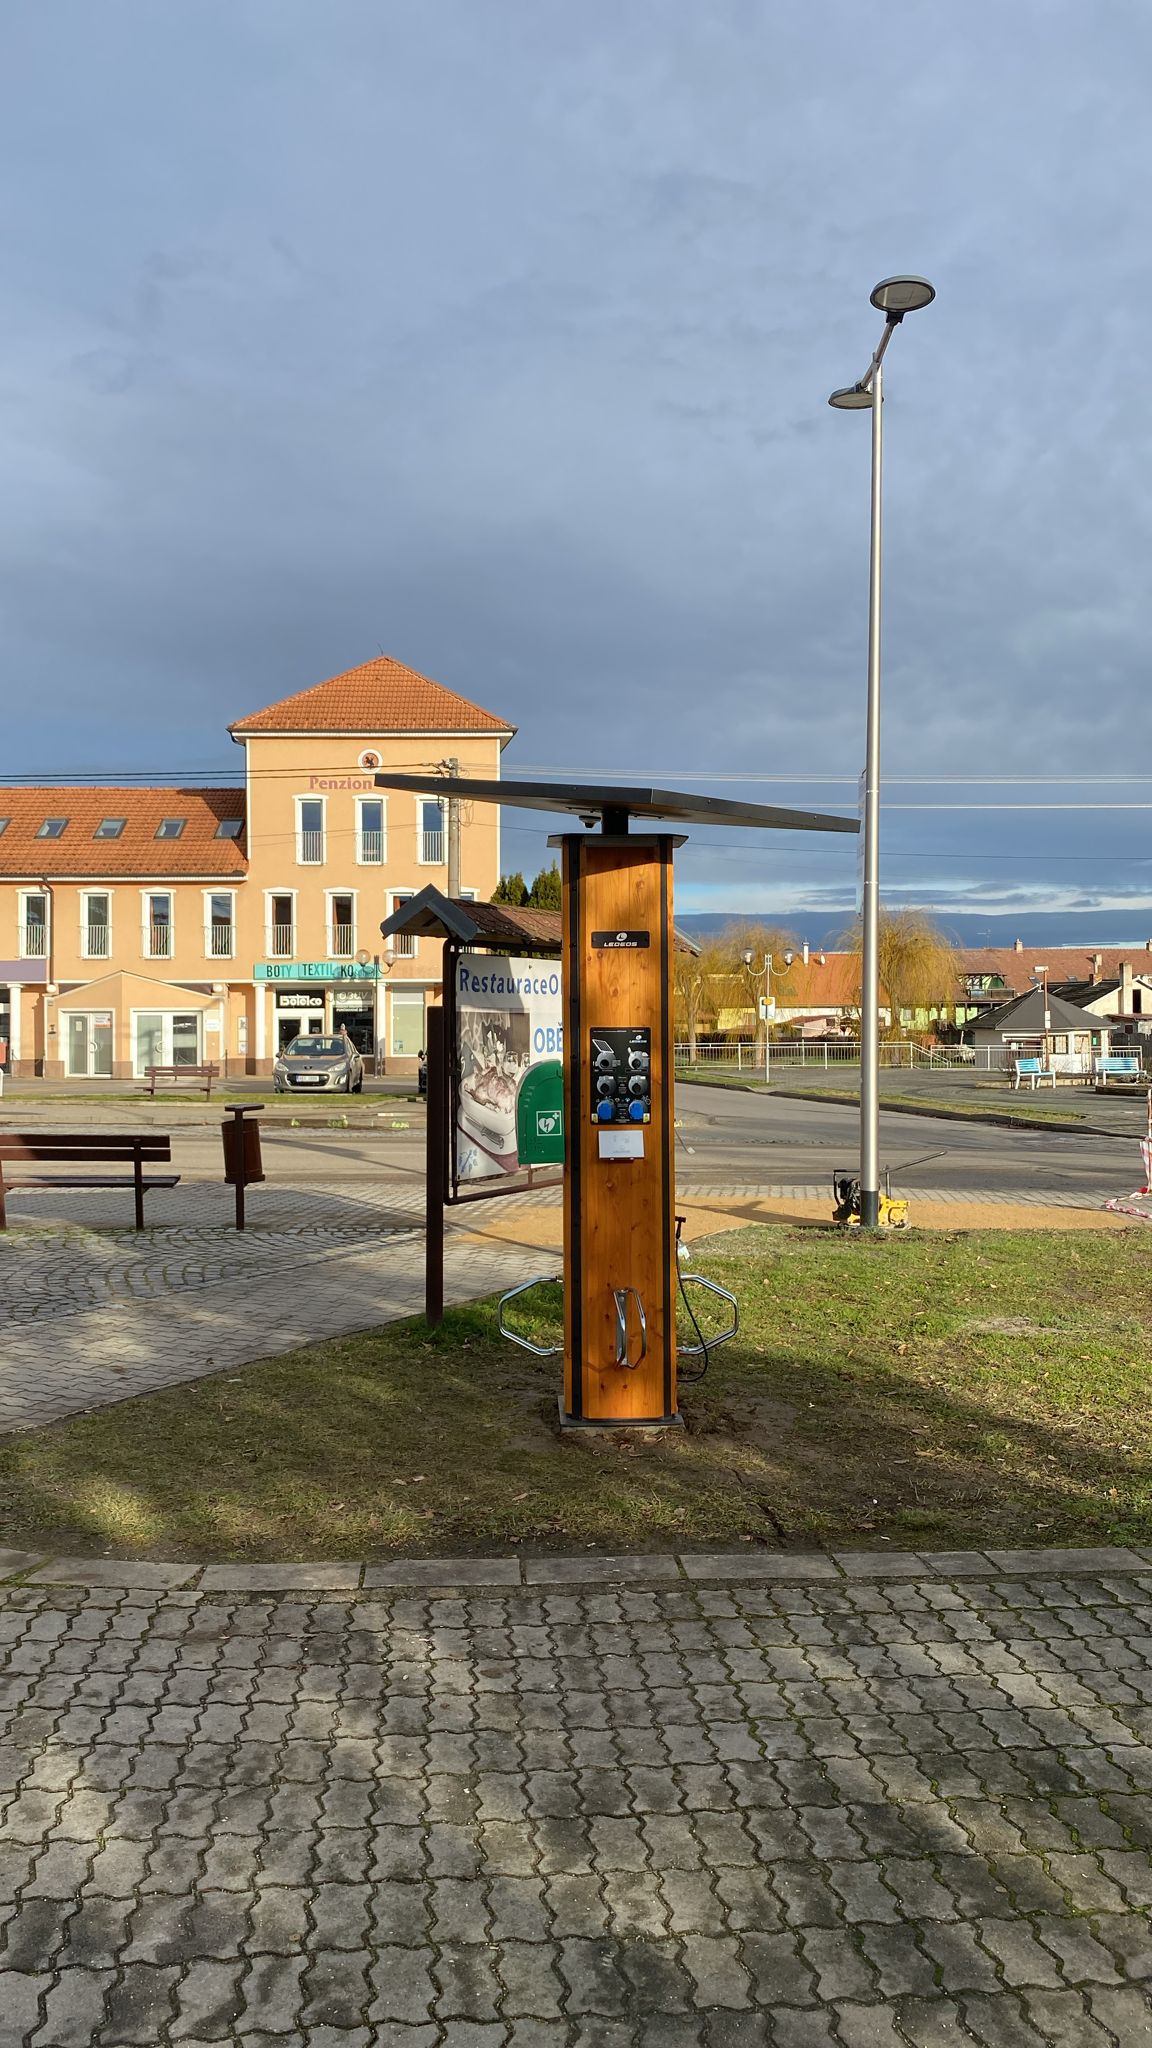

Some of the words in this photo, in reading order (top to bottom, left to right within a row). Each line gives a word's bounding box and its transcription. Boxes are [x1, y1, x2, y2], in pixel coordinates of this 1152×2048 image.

[309, 777, 373, 789] Penzion
[266, 965, 292, 977] BOTY
[302, 963, 335, 976] TEXTIL
